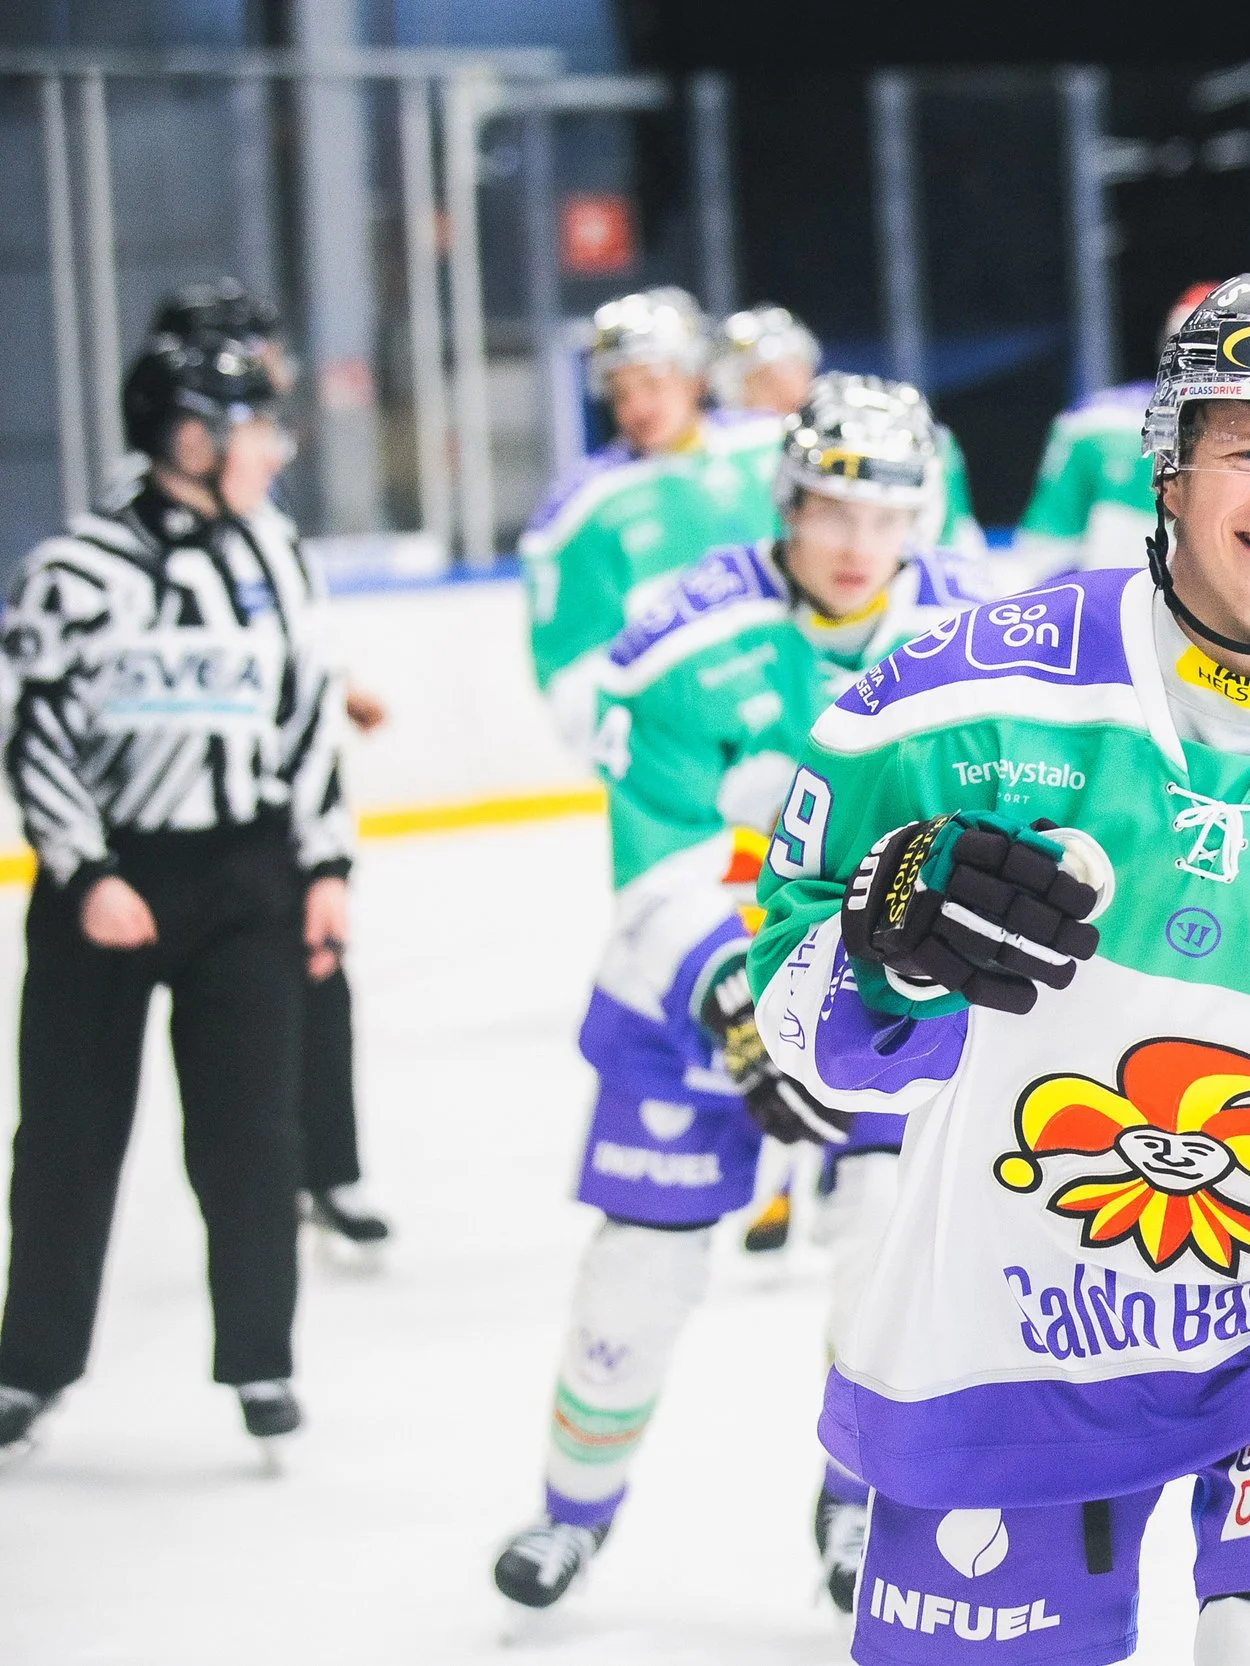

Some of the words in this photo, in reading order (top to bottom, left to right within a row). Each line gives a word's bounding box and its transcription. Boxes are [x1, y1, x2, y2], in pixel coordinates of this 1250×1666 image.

[1189, 386, 1242, 395] GLASSDRIVE
[988, 603, 1047, 626] Go
[1002, 622, 1060, 648] On
[870, 1577, 1060, 1641] INFUEL
